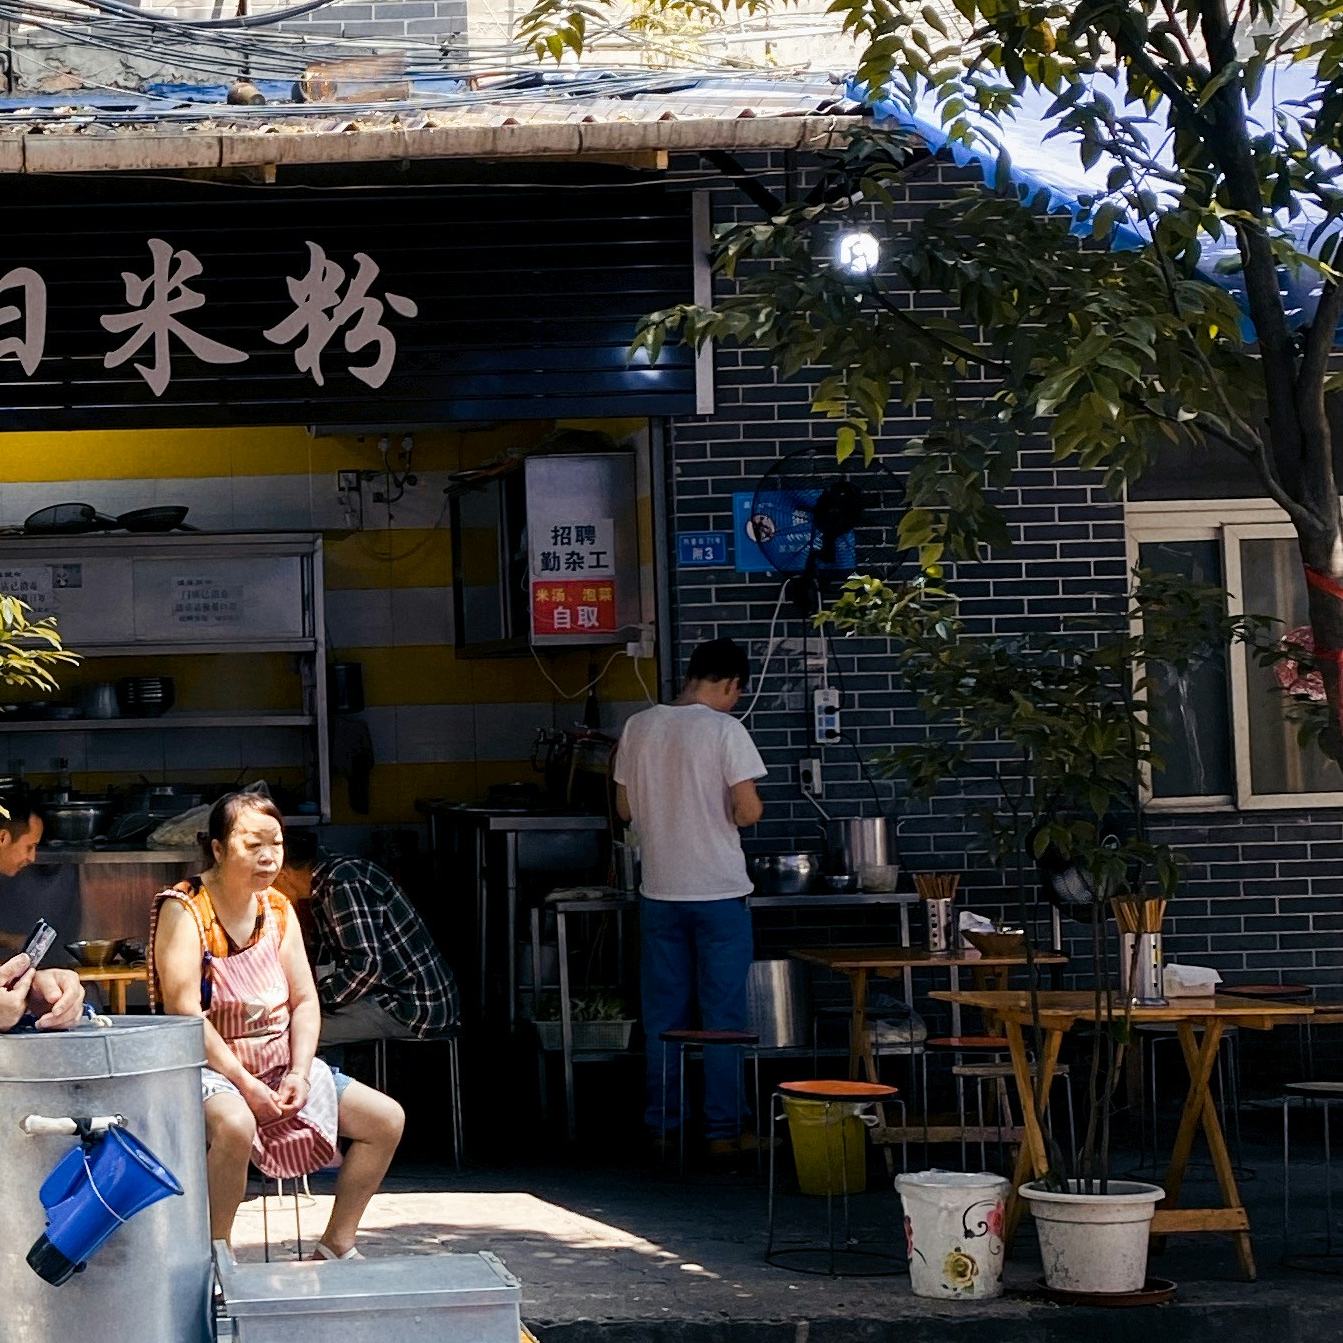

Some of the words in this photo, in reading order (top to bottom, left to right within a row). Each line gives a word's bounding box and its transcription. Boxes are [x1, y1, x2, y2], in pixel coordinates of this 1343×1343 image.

[550, 524, 596, 547] 招聘
[540, 550, 610, 572] 勤杂工
[553, 605, 599, 629] 自取
